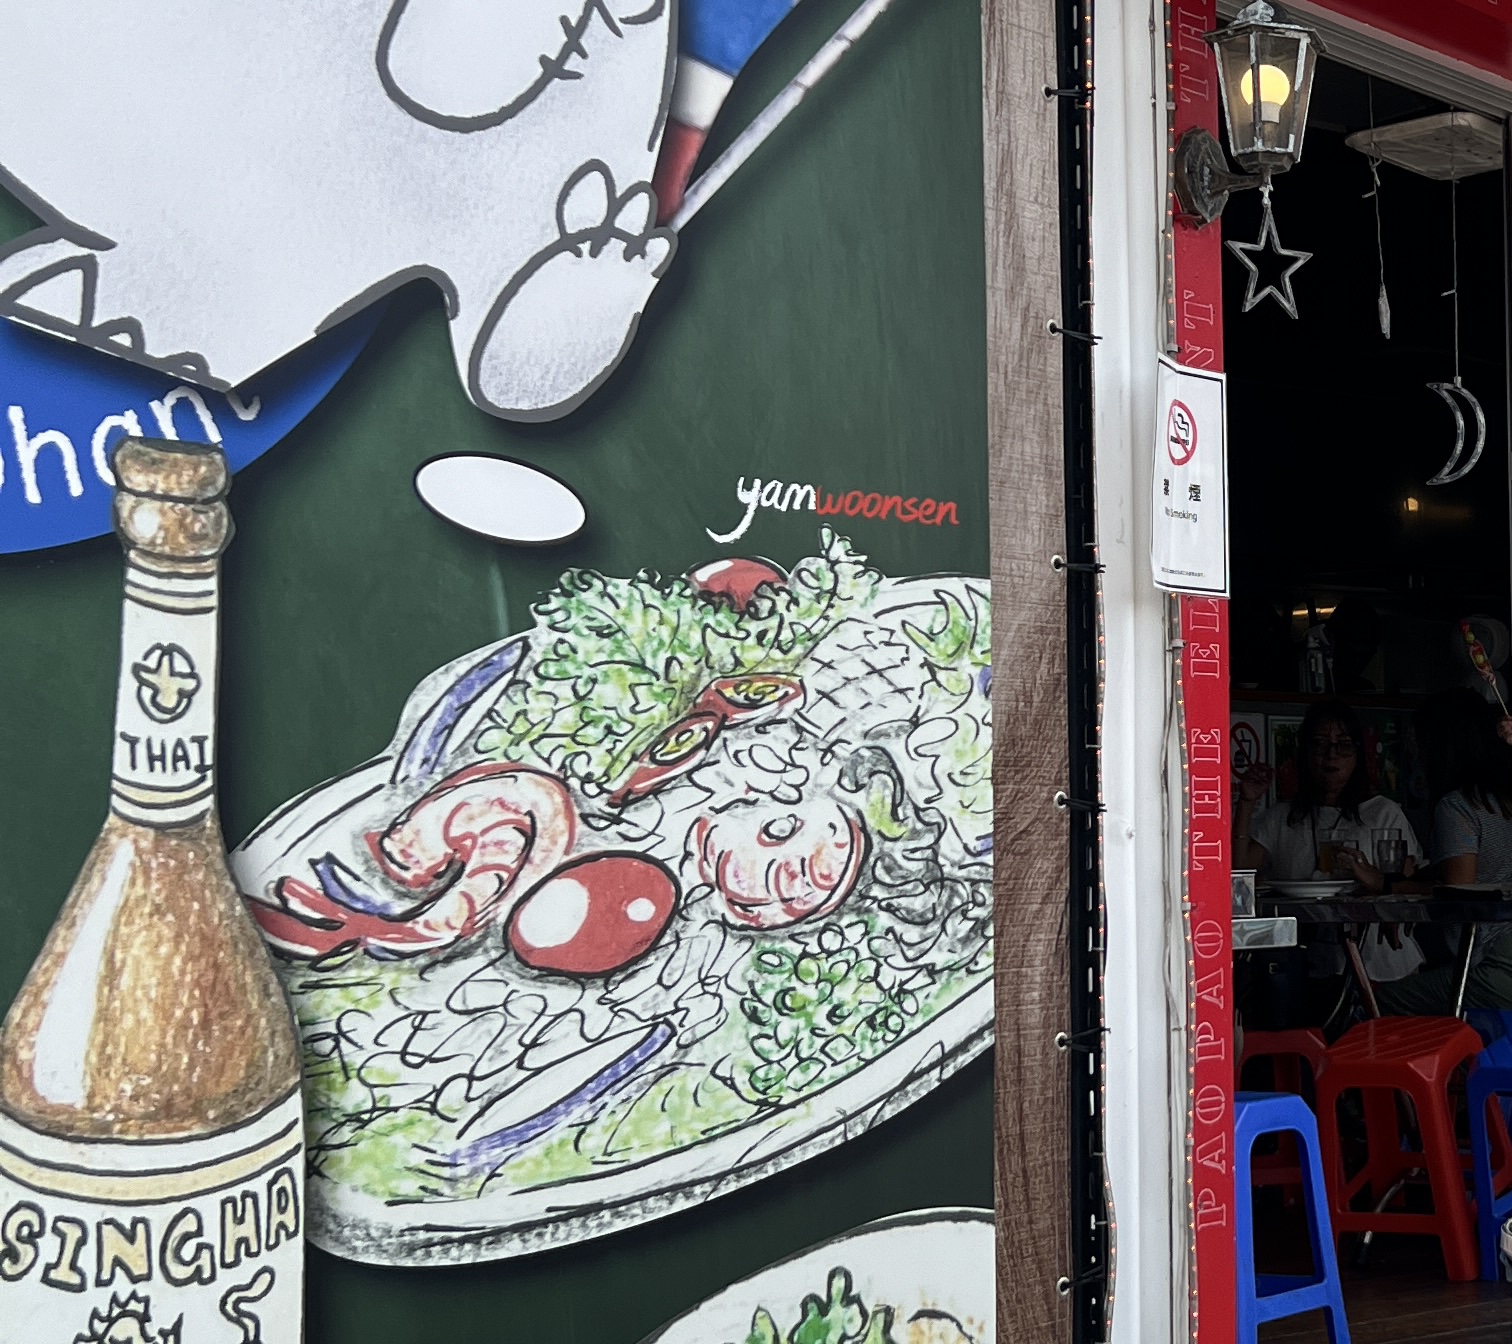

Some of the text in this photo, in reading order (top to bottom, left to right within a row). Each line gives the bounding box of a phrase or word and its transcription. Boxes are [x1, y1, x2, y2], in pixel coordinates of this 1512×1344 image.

[706, 471, 960, 545] yamwoonsen
[120, 732, 212, 777] THAI
[1189, 728, 1222, 871] THE
[1193, 919, 1225, 1063] PAO
[1196, 1084, 1227, 1230] PAO
[0, 1166, 302, 1293] SINGHA
